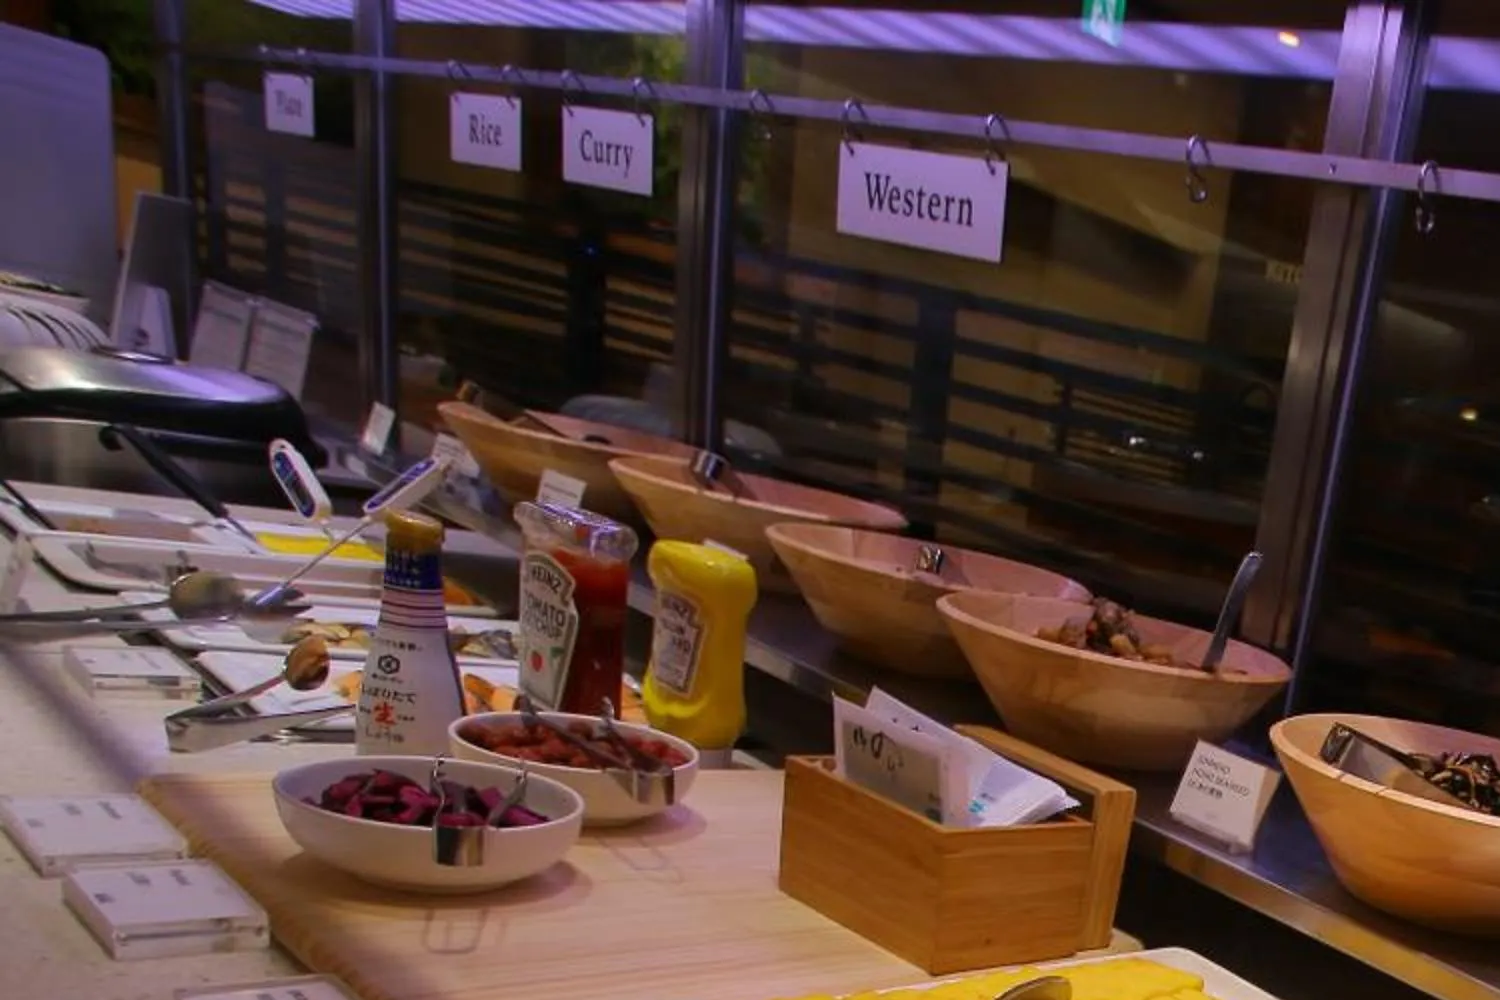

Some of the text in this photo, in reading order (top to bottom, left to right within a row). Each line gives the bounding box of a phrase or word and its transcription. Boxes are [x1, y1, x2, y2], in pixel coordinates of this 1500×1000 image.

[467, 112, 503, 147] Rice
[579, 128, 634, 178] Curry
[864, 171, 974, 228] Western
[531, 565, 562, 594] HEINZ
[372, 702, 397, 726] 生
